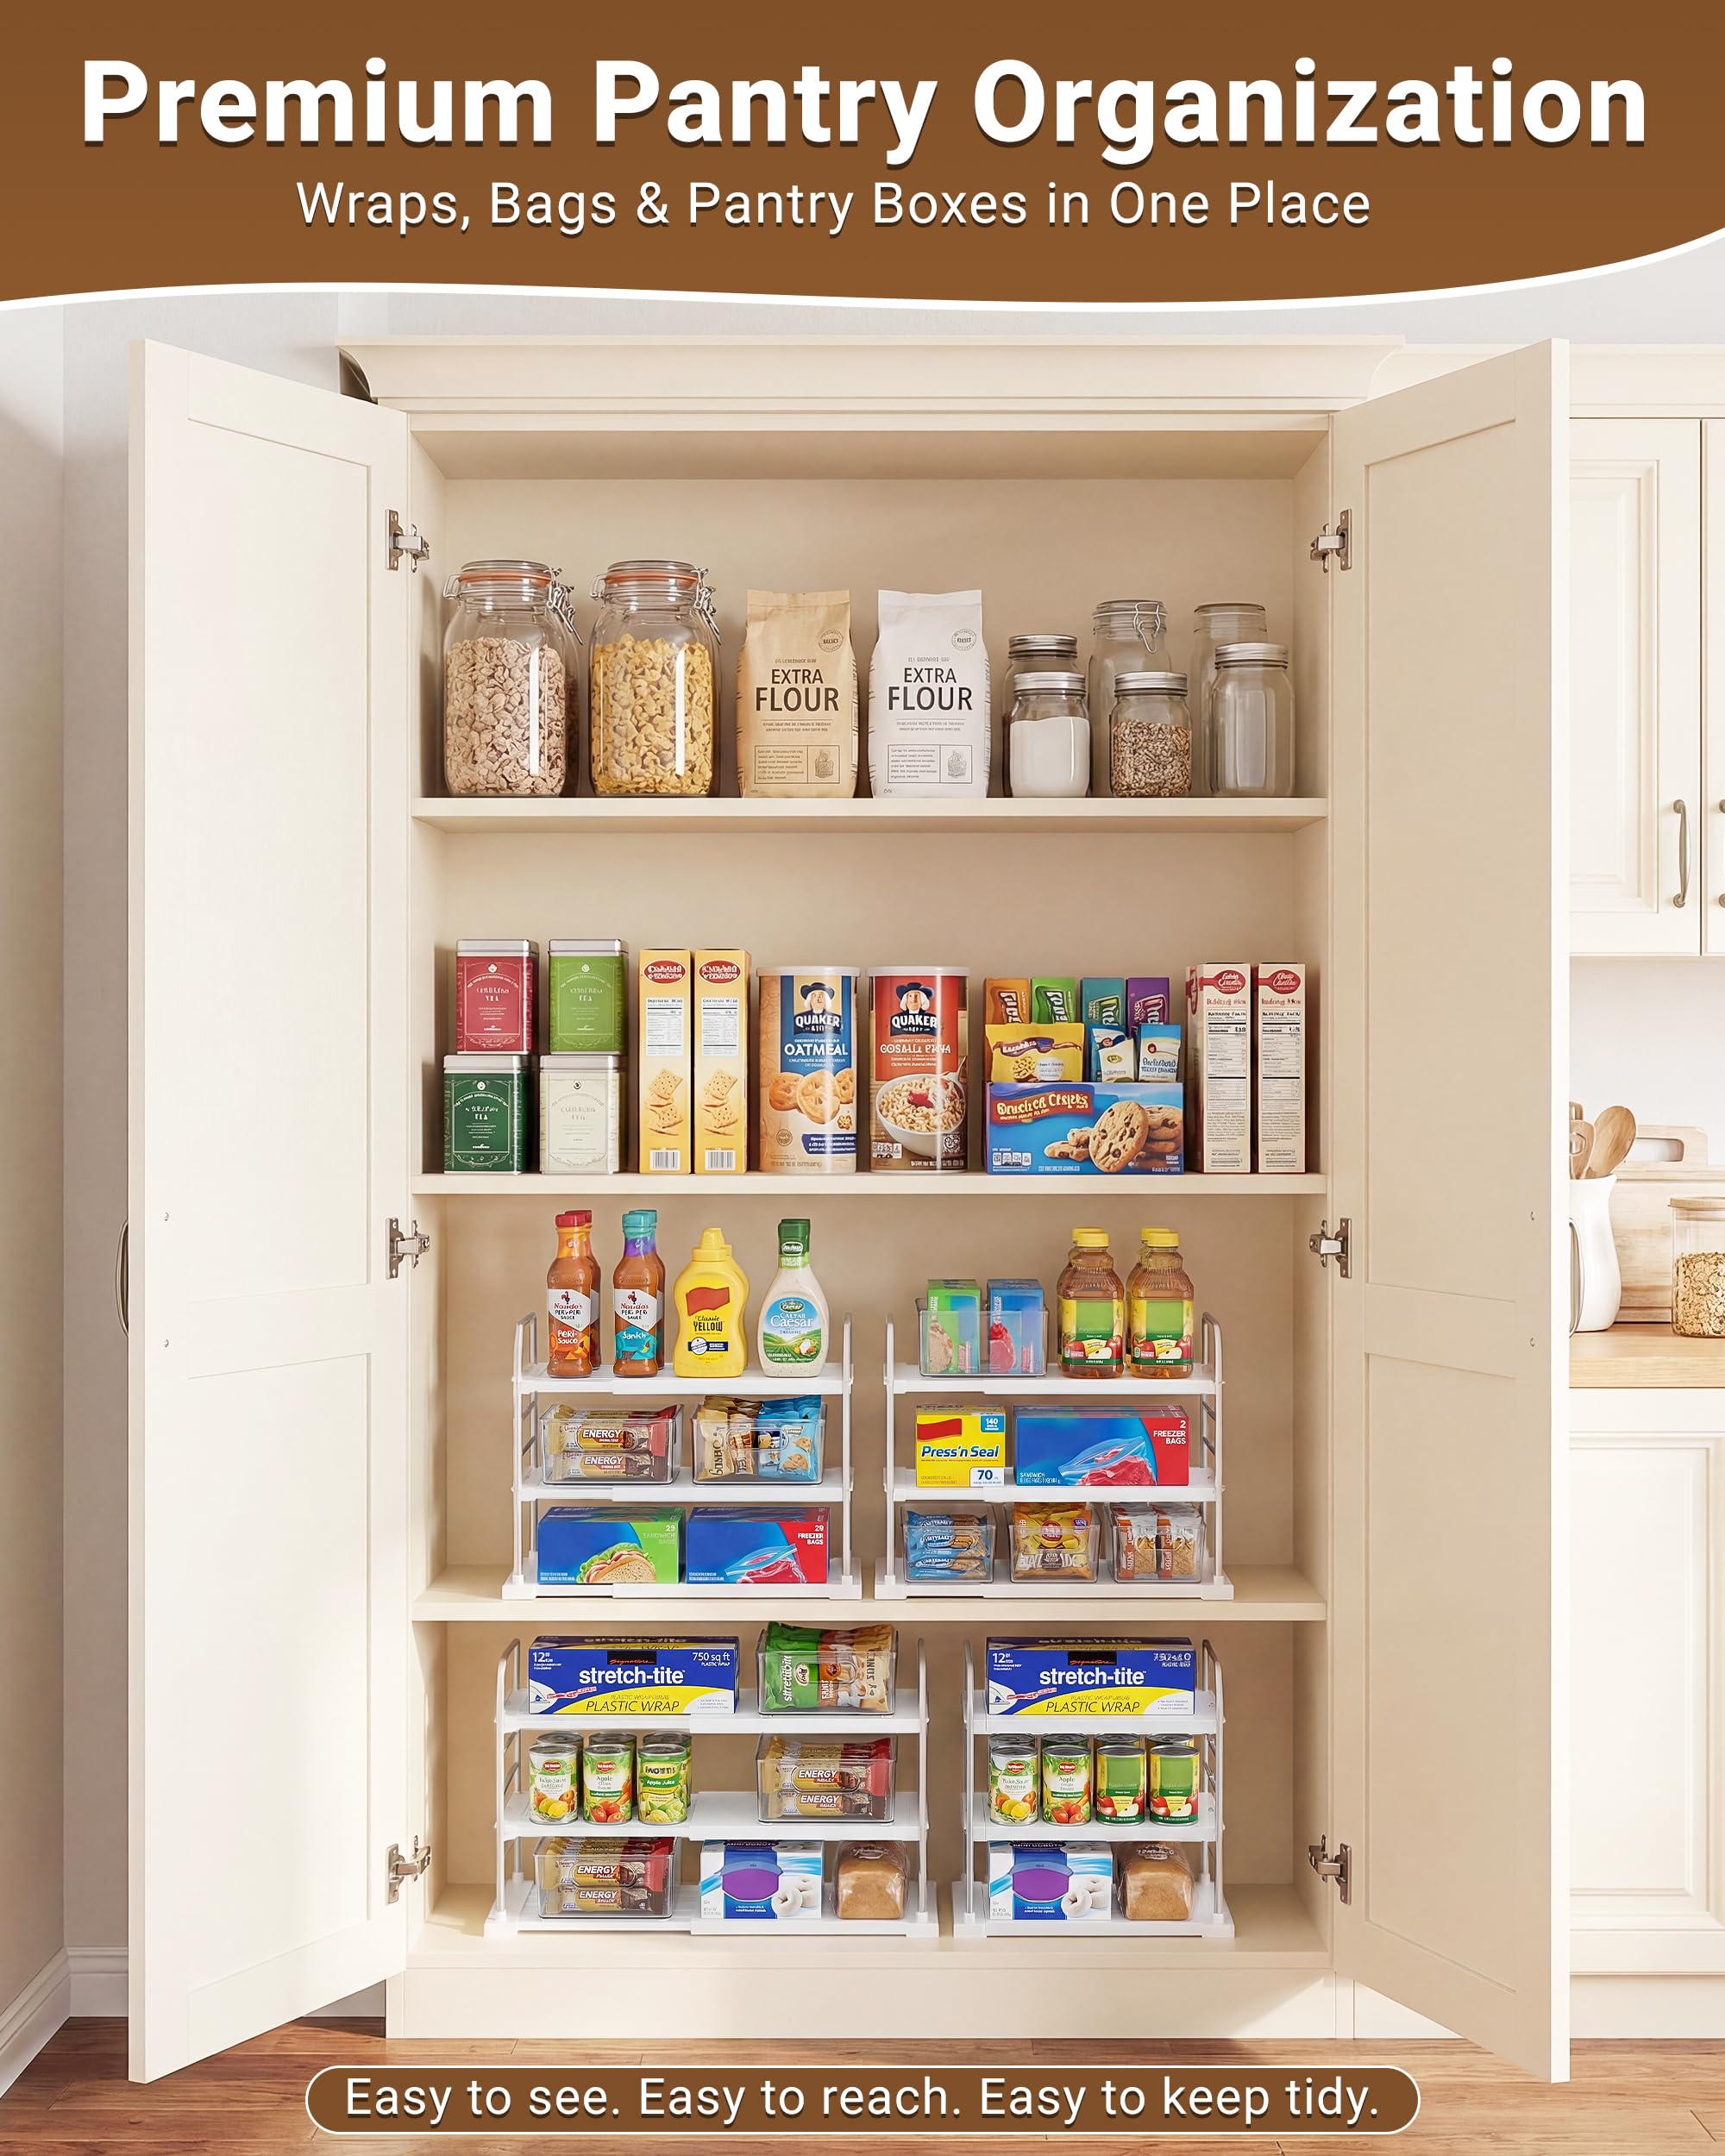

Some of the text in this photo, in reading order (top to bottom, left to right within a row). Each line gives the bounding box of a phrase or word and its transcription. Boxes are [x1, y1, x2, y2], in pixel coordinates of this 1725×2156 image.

[771, 668, 824, 684] EXTRA
[904, 667, 957, 683] EXTRA
[756, 686, 839, 711] FLOUR
[888, 686, 973, 711] FLOUR
[795, 1015, 840, 1028] QUAKER
[892, 1015, 938, 1029] QUAKER
[784, 1044, 848, 1056] OATMEAL
[693, 1321, 723, 1332] YELLOW
[770, 1315, 813, 1327] Caesar
[582, 1429, 622, 1438] ENERGY
[921, 1445, 1000, 1457] Press'n Seal
[584, 1456, 624, 1465] ENERGY
[977, 1470, 993, 1480] 70
[532, 1652, 546, 1663] 12
[692, 1651, 731, 1664] 750 sq ft
[992, 1653, 1006, 1664] 12
[586, 1701, 680, 1712] PLASTIC WRAP
[1046, 1702, 1140, 1713] PLASTIC WRAP
[799, 1770, 837, 1778] ENERGY
[800, 1795, 839, 1803] ENERGY
[577, 1865, 617, 1874] ENERGY
[579, 1890, 618, 1899] ENERGY
